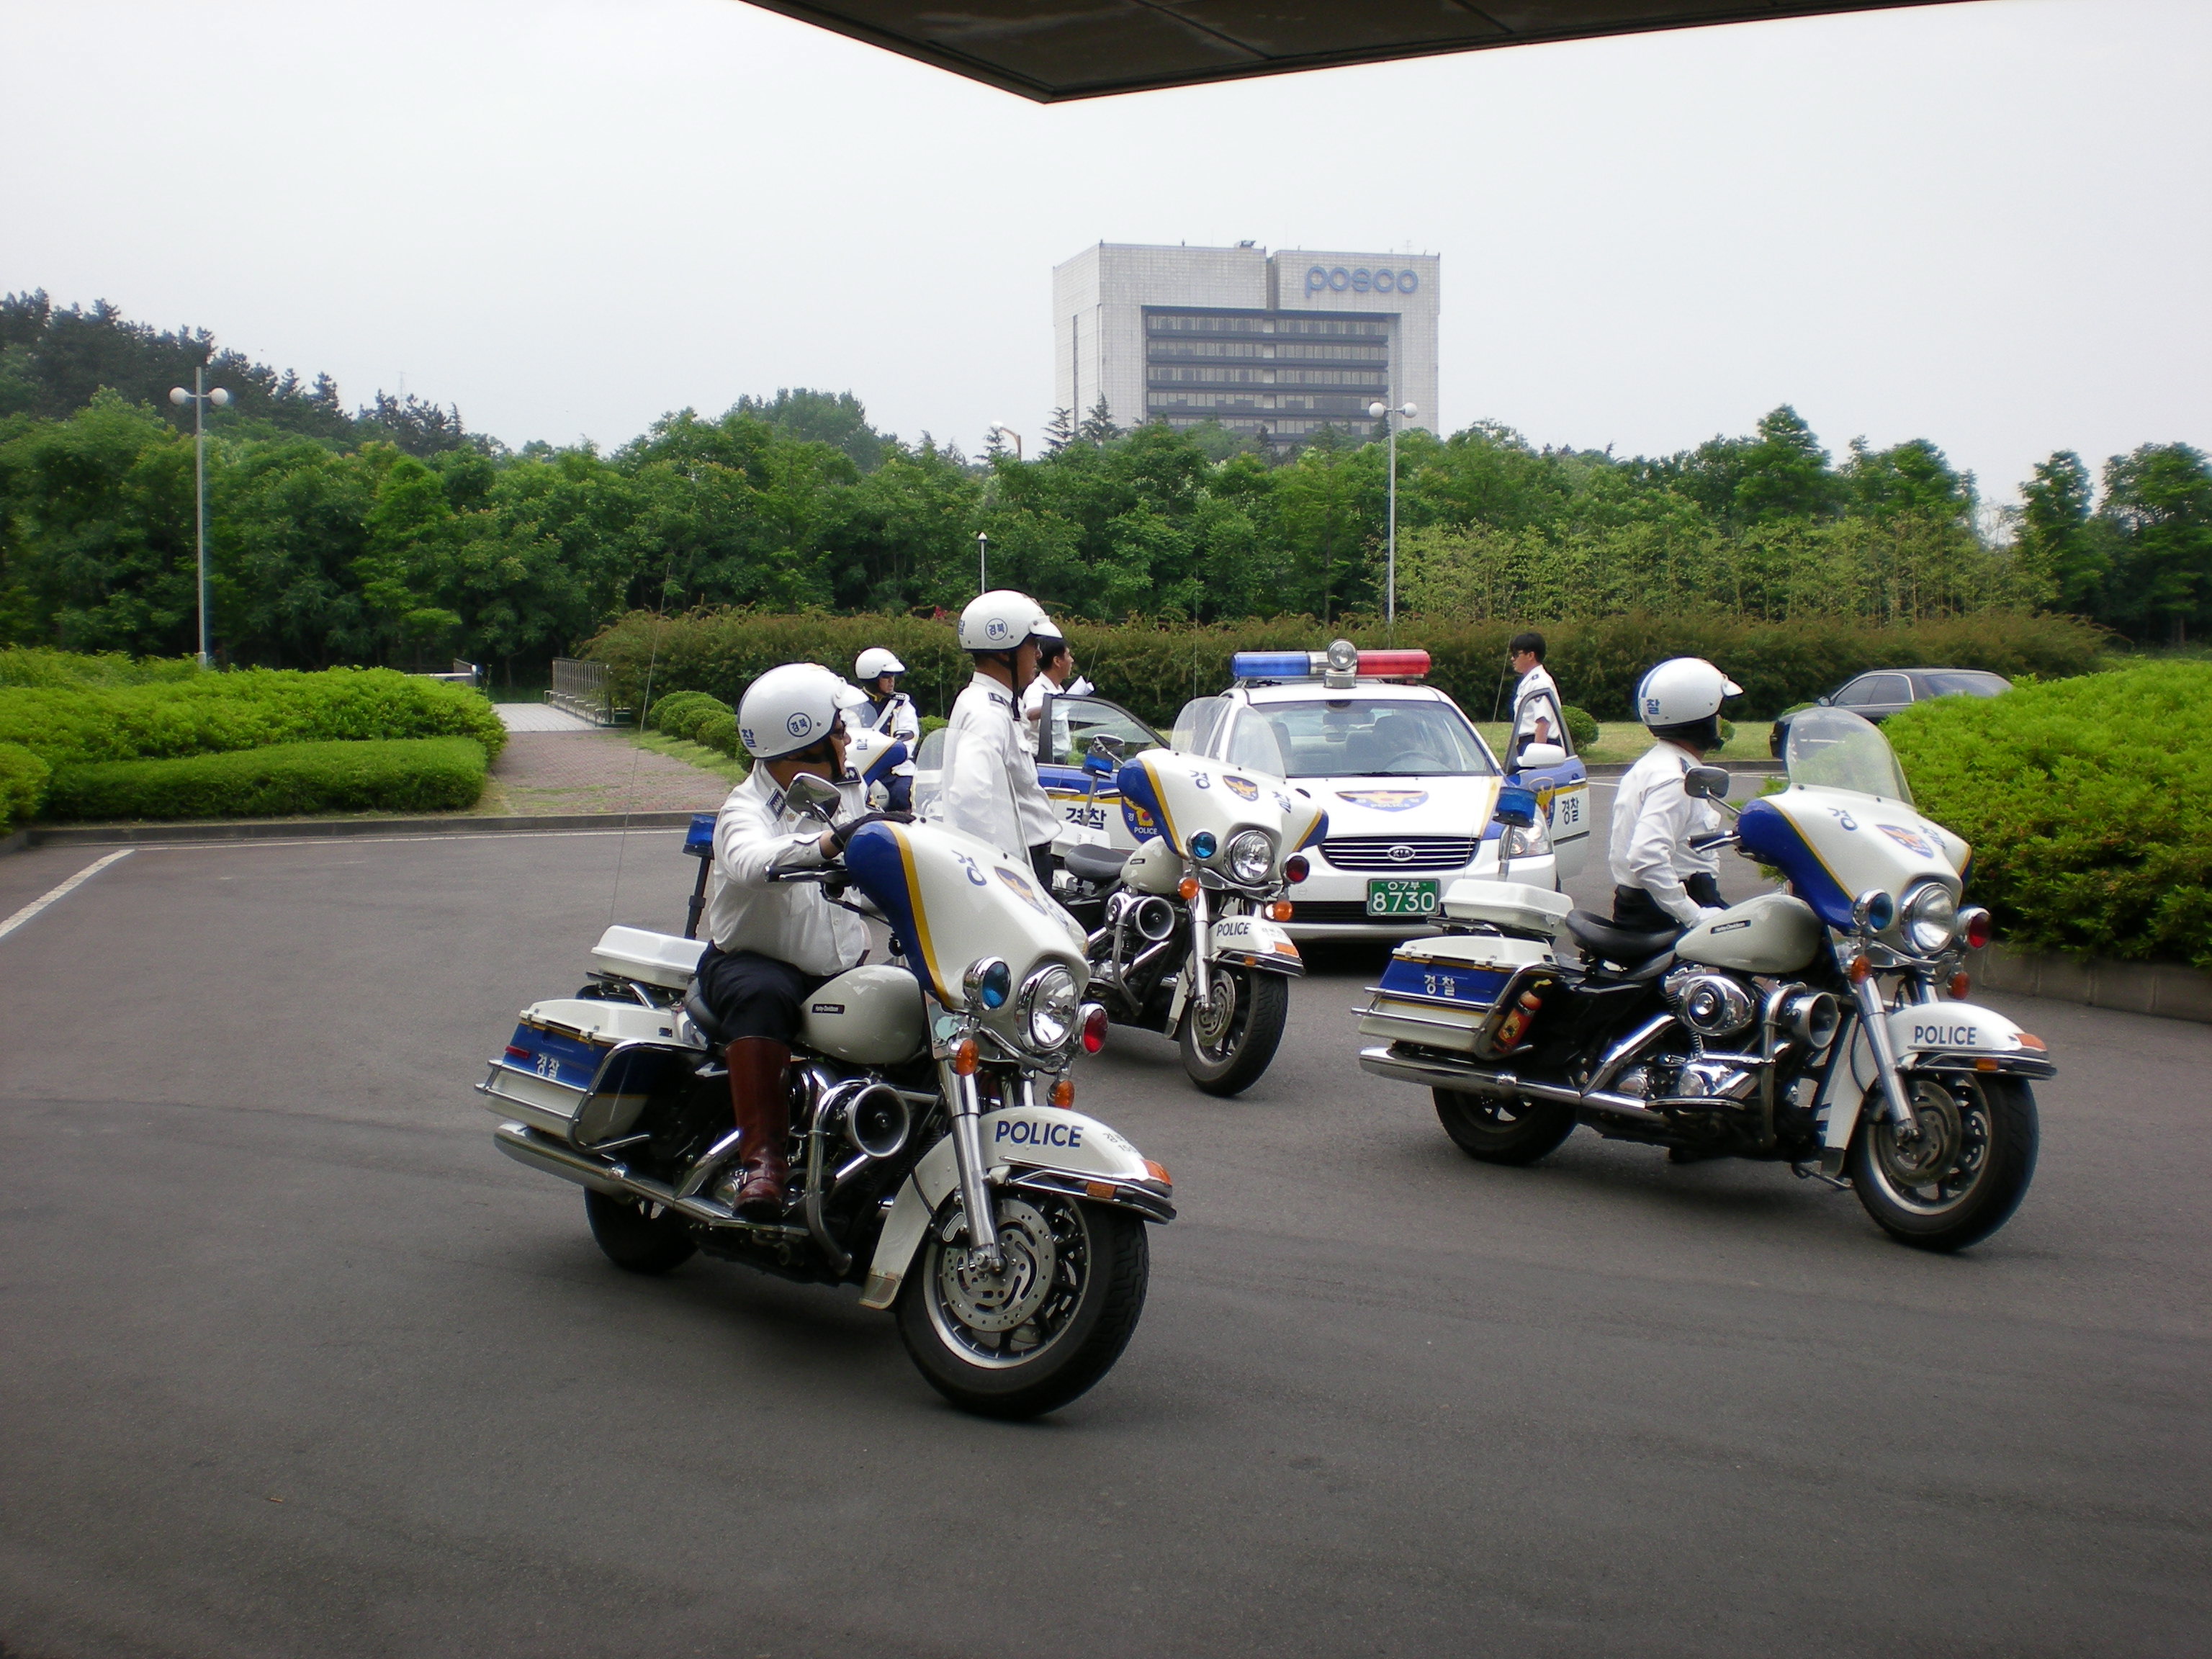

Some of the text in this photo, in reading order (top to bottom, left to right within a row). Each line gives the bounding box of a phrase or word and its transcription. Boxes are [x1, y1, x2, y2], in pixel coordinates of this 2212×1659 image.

[1305, 266, 1419, 298] posco
[989, 623, 1005, 636] 경북
[791, 718, 809, 733] 경북
[1189, 770, 1210, 789] 경
[1562, 796, 1579, 824] 경찰
[1827, 807, 1858, 831] 경
[1134, 826, 1157, 835] POLICE
[951, 850, 987, 886] 경
[1388, 881, 1421, 891] 07부
[1372, 892, 1435, 912] 8730
[1217, 922, 1251, 937] POLICE
[1424, 974, 1455, 997] 경찰
[1914, 1025, 1977, 1045] POLICE
[537, 1053, 559, 1079] 경찰
[995, 1120, 1084, 1148] POLICE
